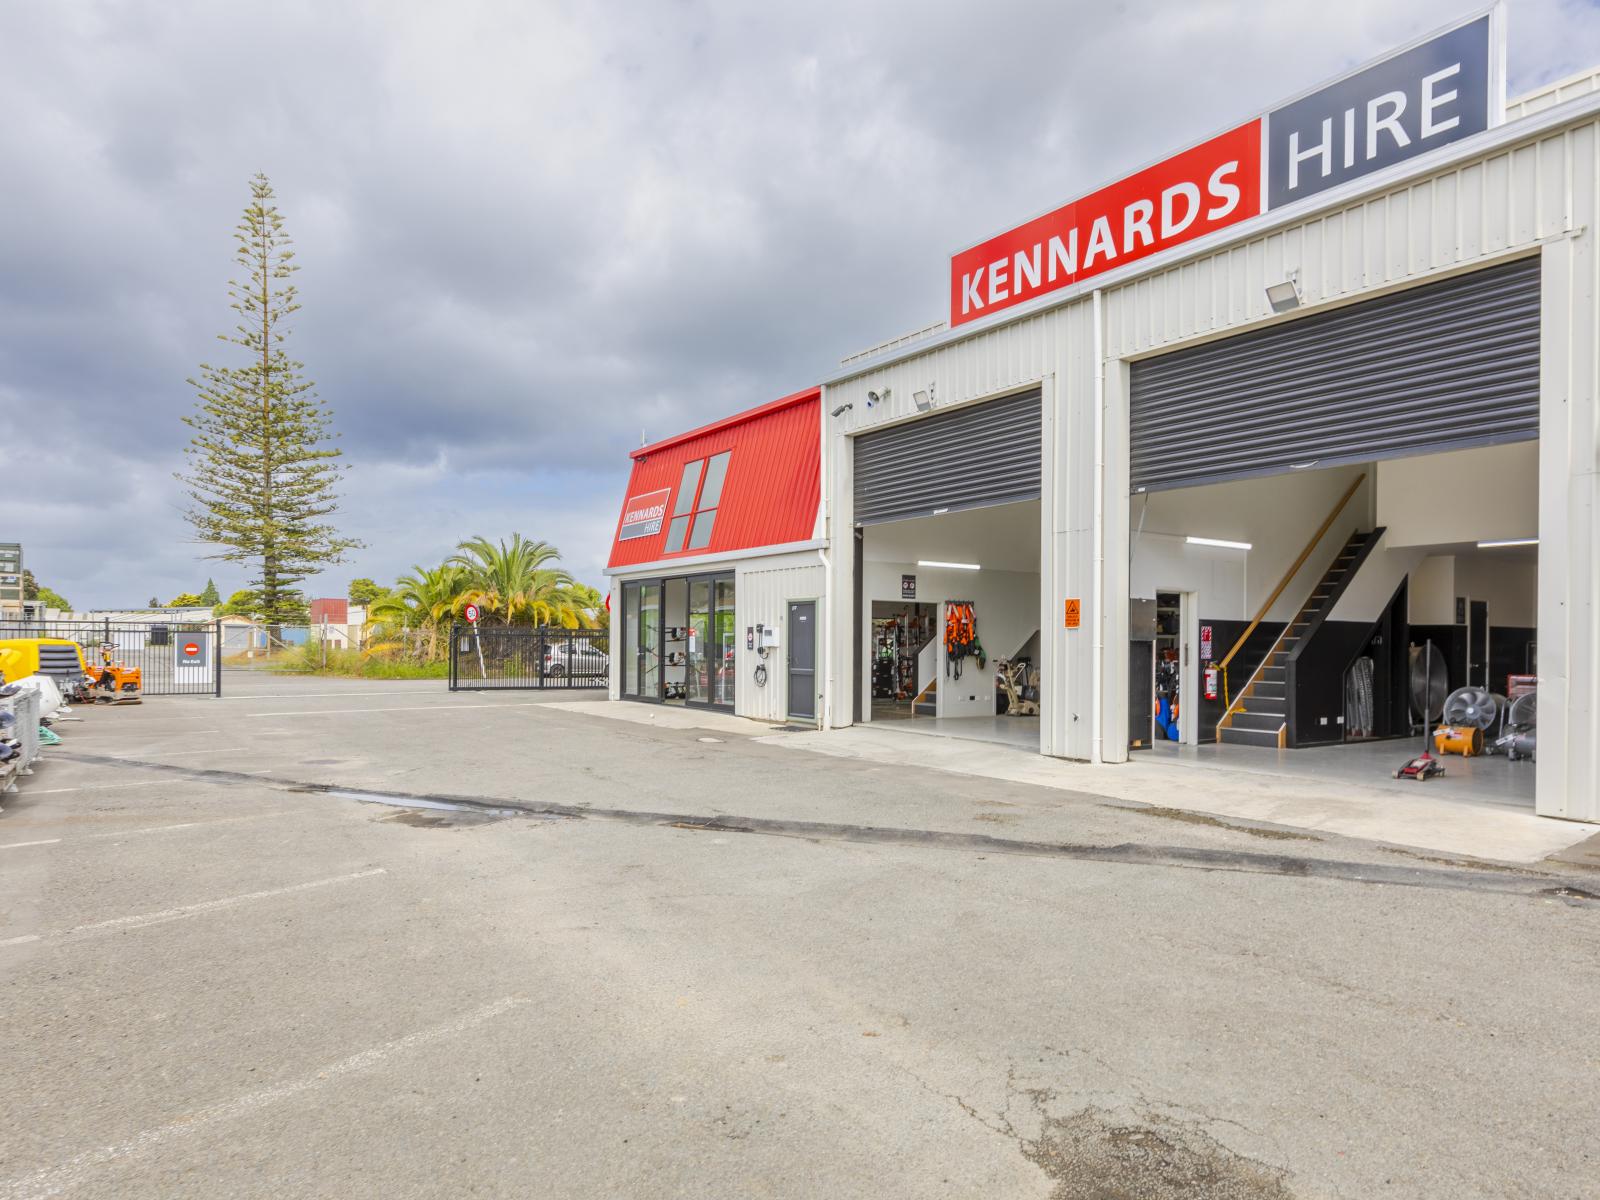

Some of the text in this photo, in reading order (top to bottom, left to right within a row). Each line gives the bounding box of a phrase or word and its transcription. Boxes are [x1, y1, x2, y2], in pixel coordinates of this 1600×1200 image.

[962, 62, 1461, 315] KENNARDS HIRE
[625, 505, 664, 522] KENNARDS
[644, 520, 660, 534] HIRE
